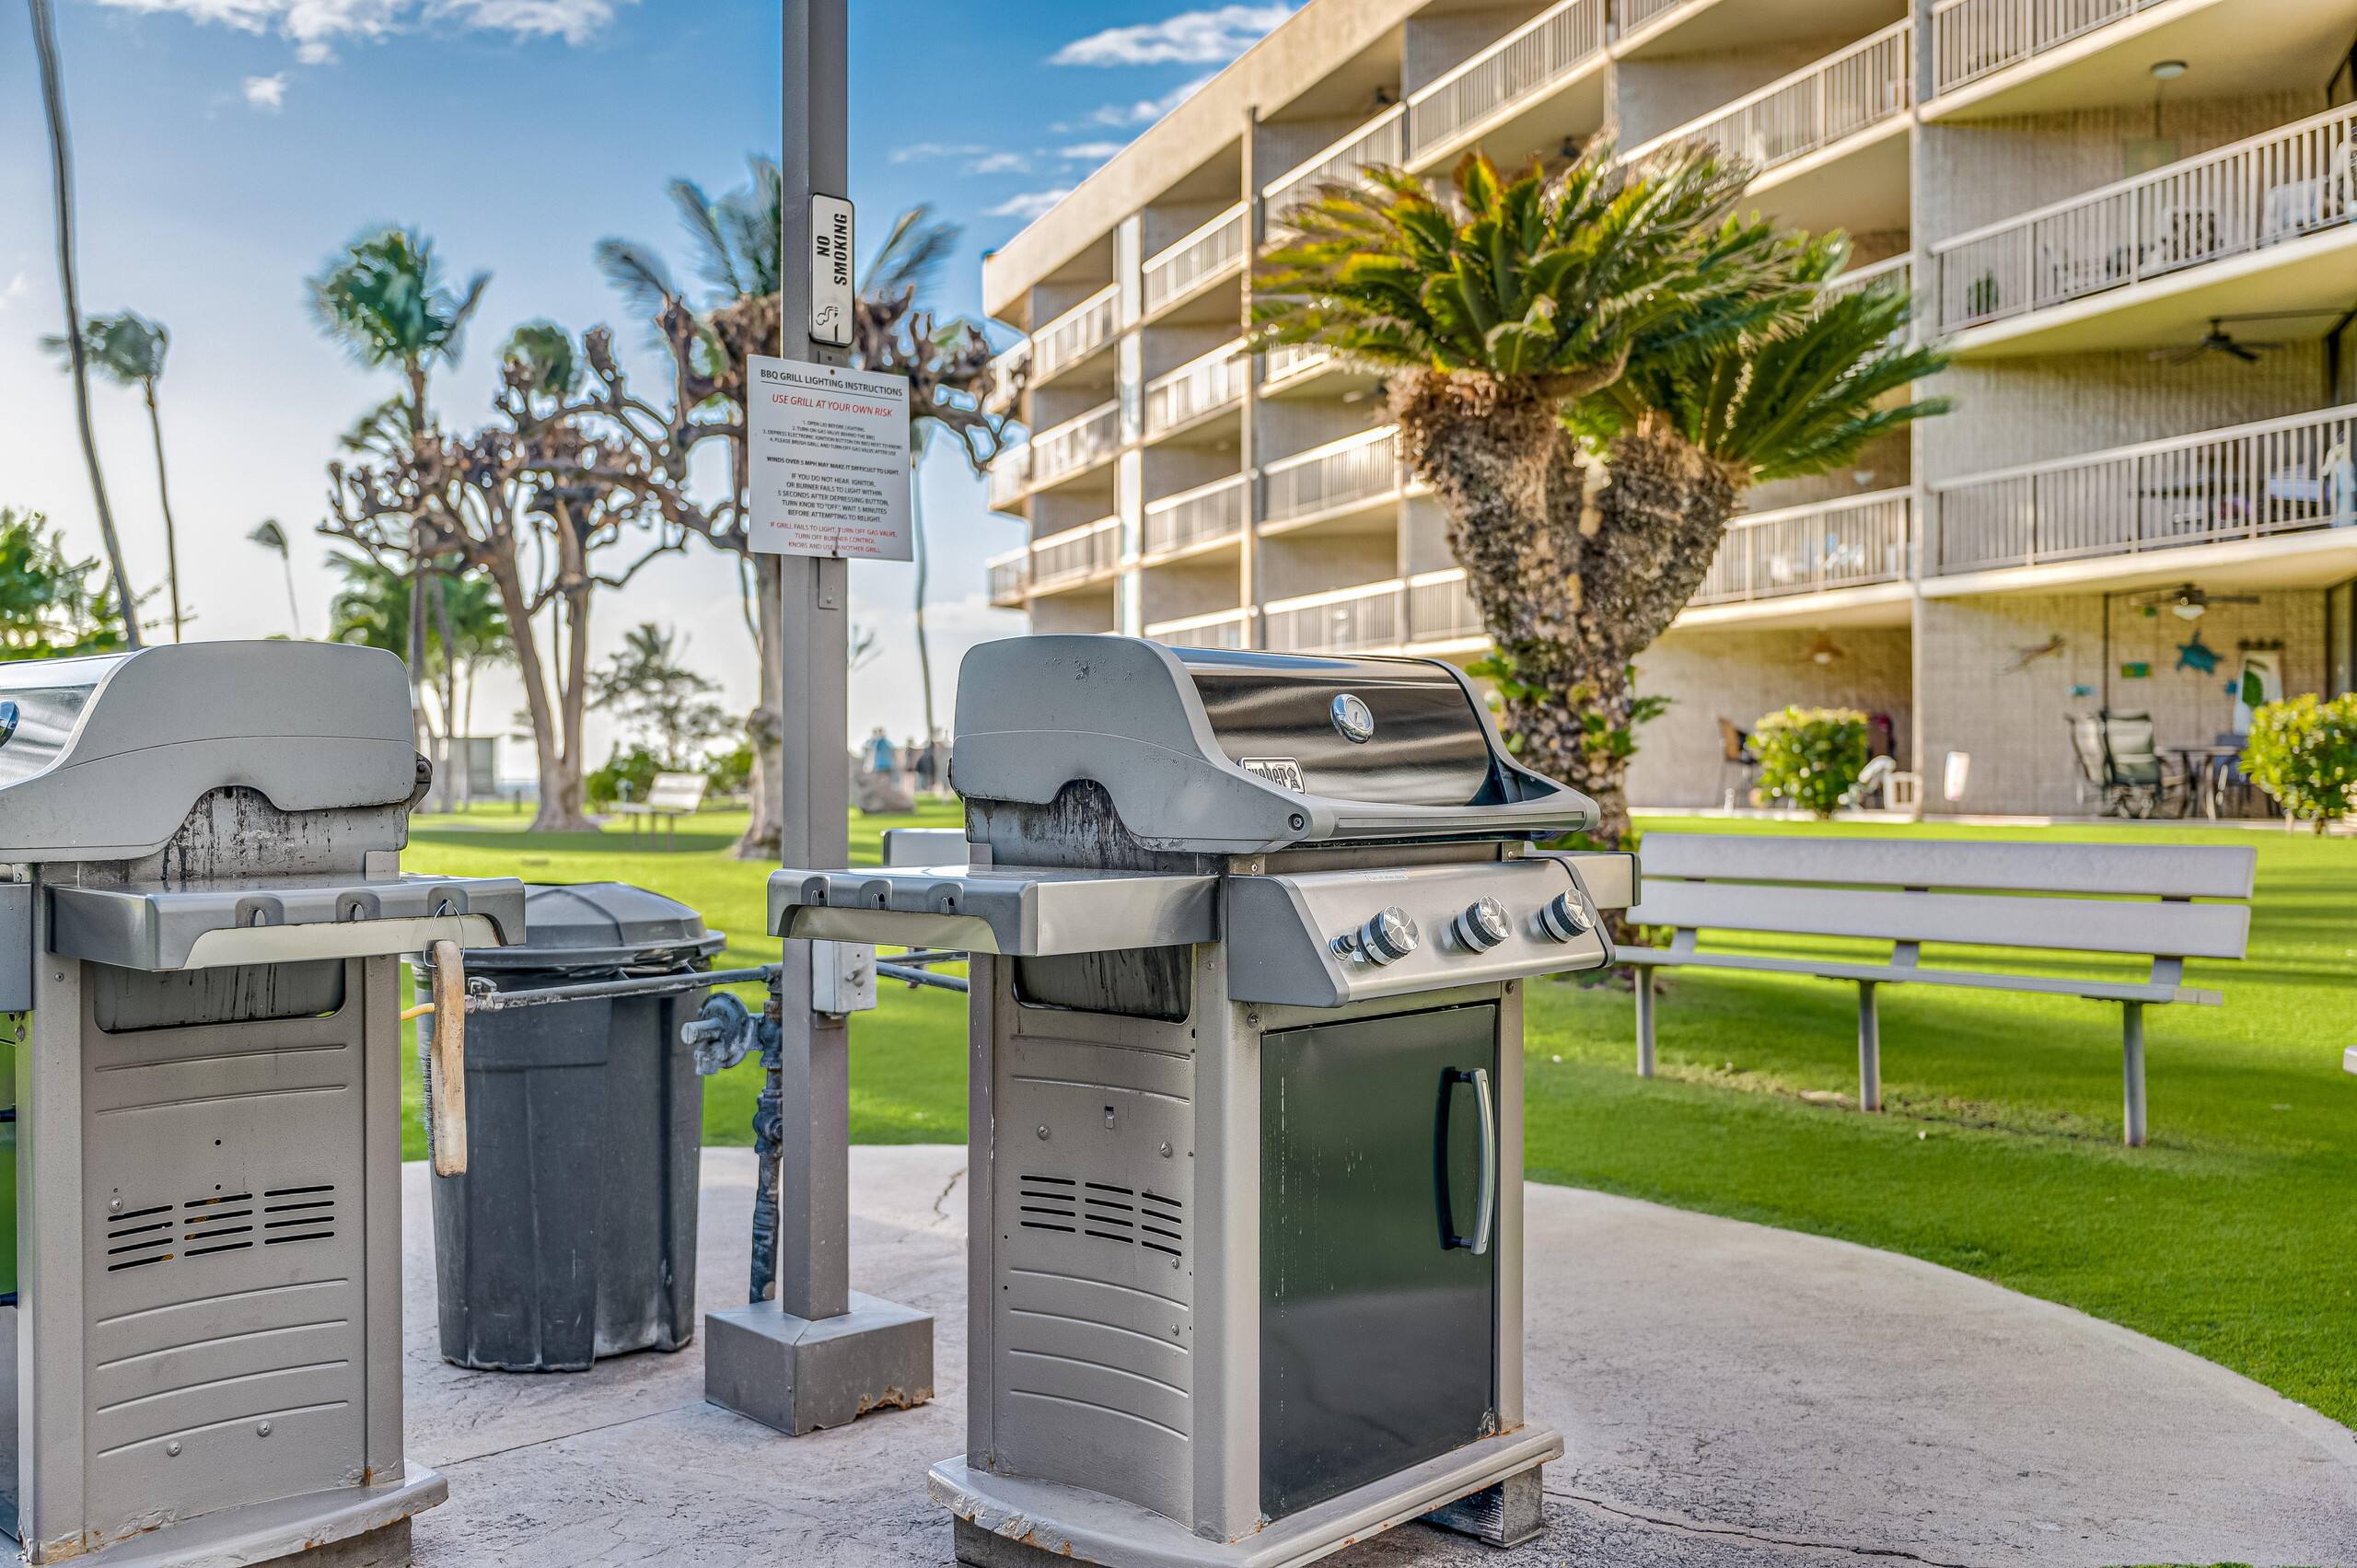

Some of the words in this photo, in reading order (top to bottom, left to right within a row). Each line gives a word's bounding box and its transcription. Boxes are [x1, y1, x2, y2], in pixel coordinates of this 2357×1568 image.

[818, 236, 830, 257] NO
[834, 214, 847, 285] SMOKING
[761, 369, 778, 380] BBQ
[780, 372, 803, 383] GRILL
[806, 376, 843, 389] LIGHTING
[845, 381, 903, 397] INSTRUCTIONS
[772, 394, 789, 404] USE
[791, 397, 814, 408] GRILL
[816, 400, 826, 409] AT
[829, 401, 851, 412] YOUR
[853, 405, 873, 415] OWN
[875, 407, 893, 417] RISK
[852, 465, 876, 473] DIFFICULT
[783, 490, 810, 499] SECONDS
[830, 494, 865, 504] DEPRESSING
[795, 482, 819, 491] BURNER
[819, 484, 835, 493] FAILS
[811, 511, 848, 520] ATTEMPTING
[1247, 761, 1288, 788] eber
